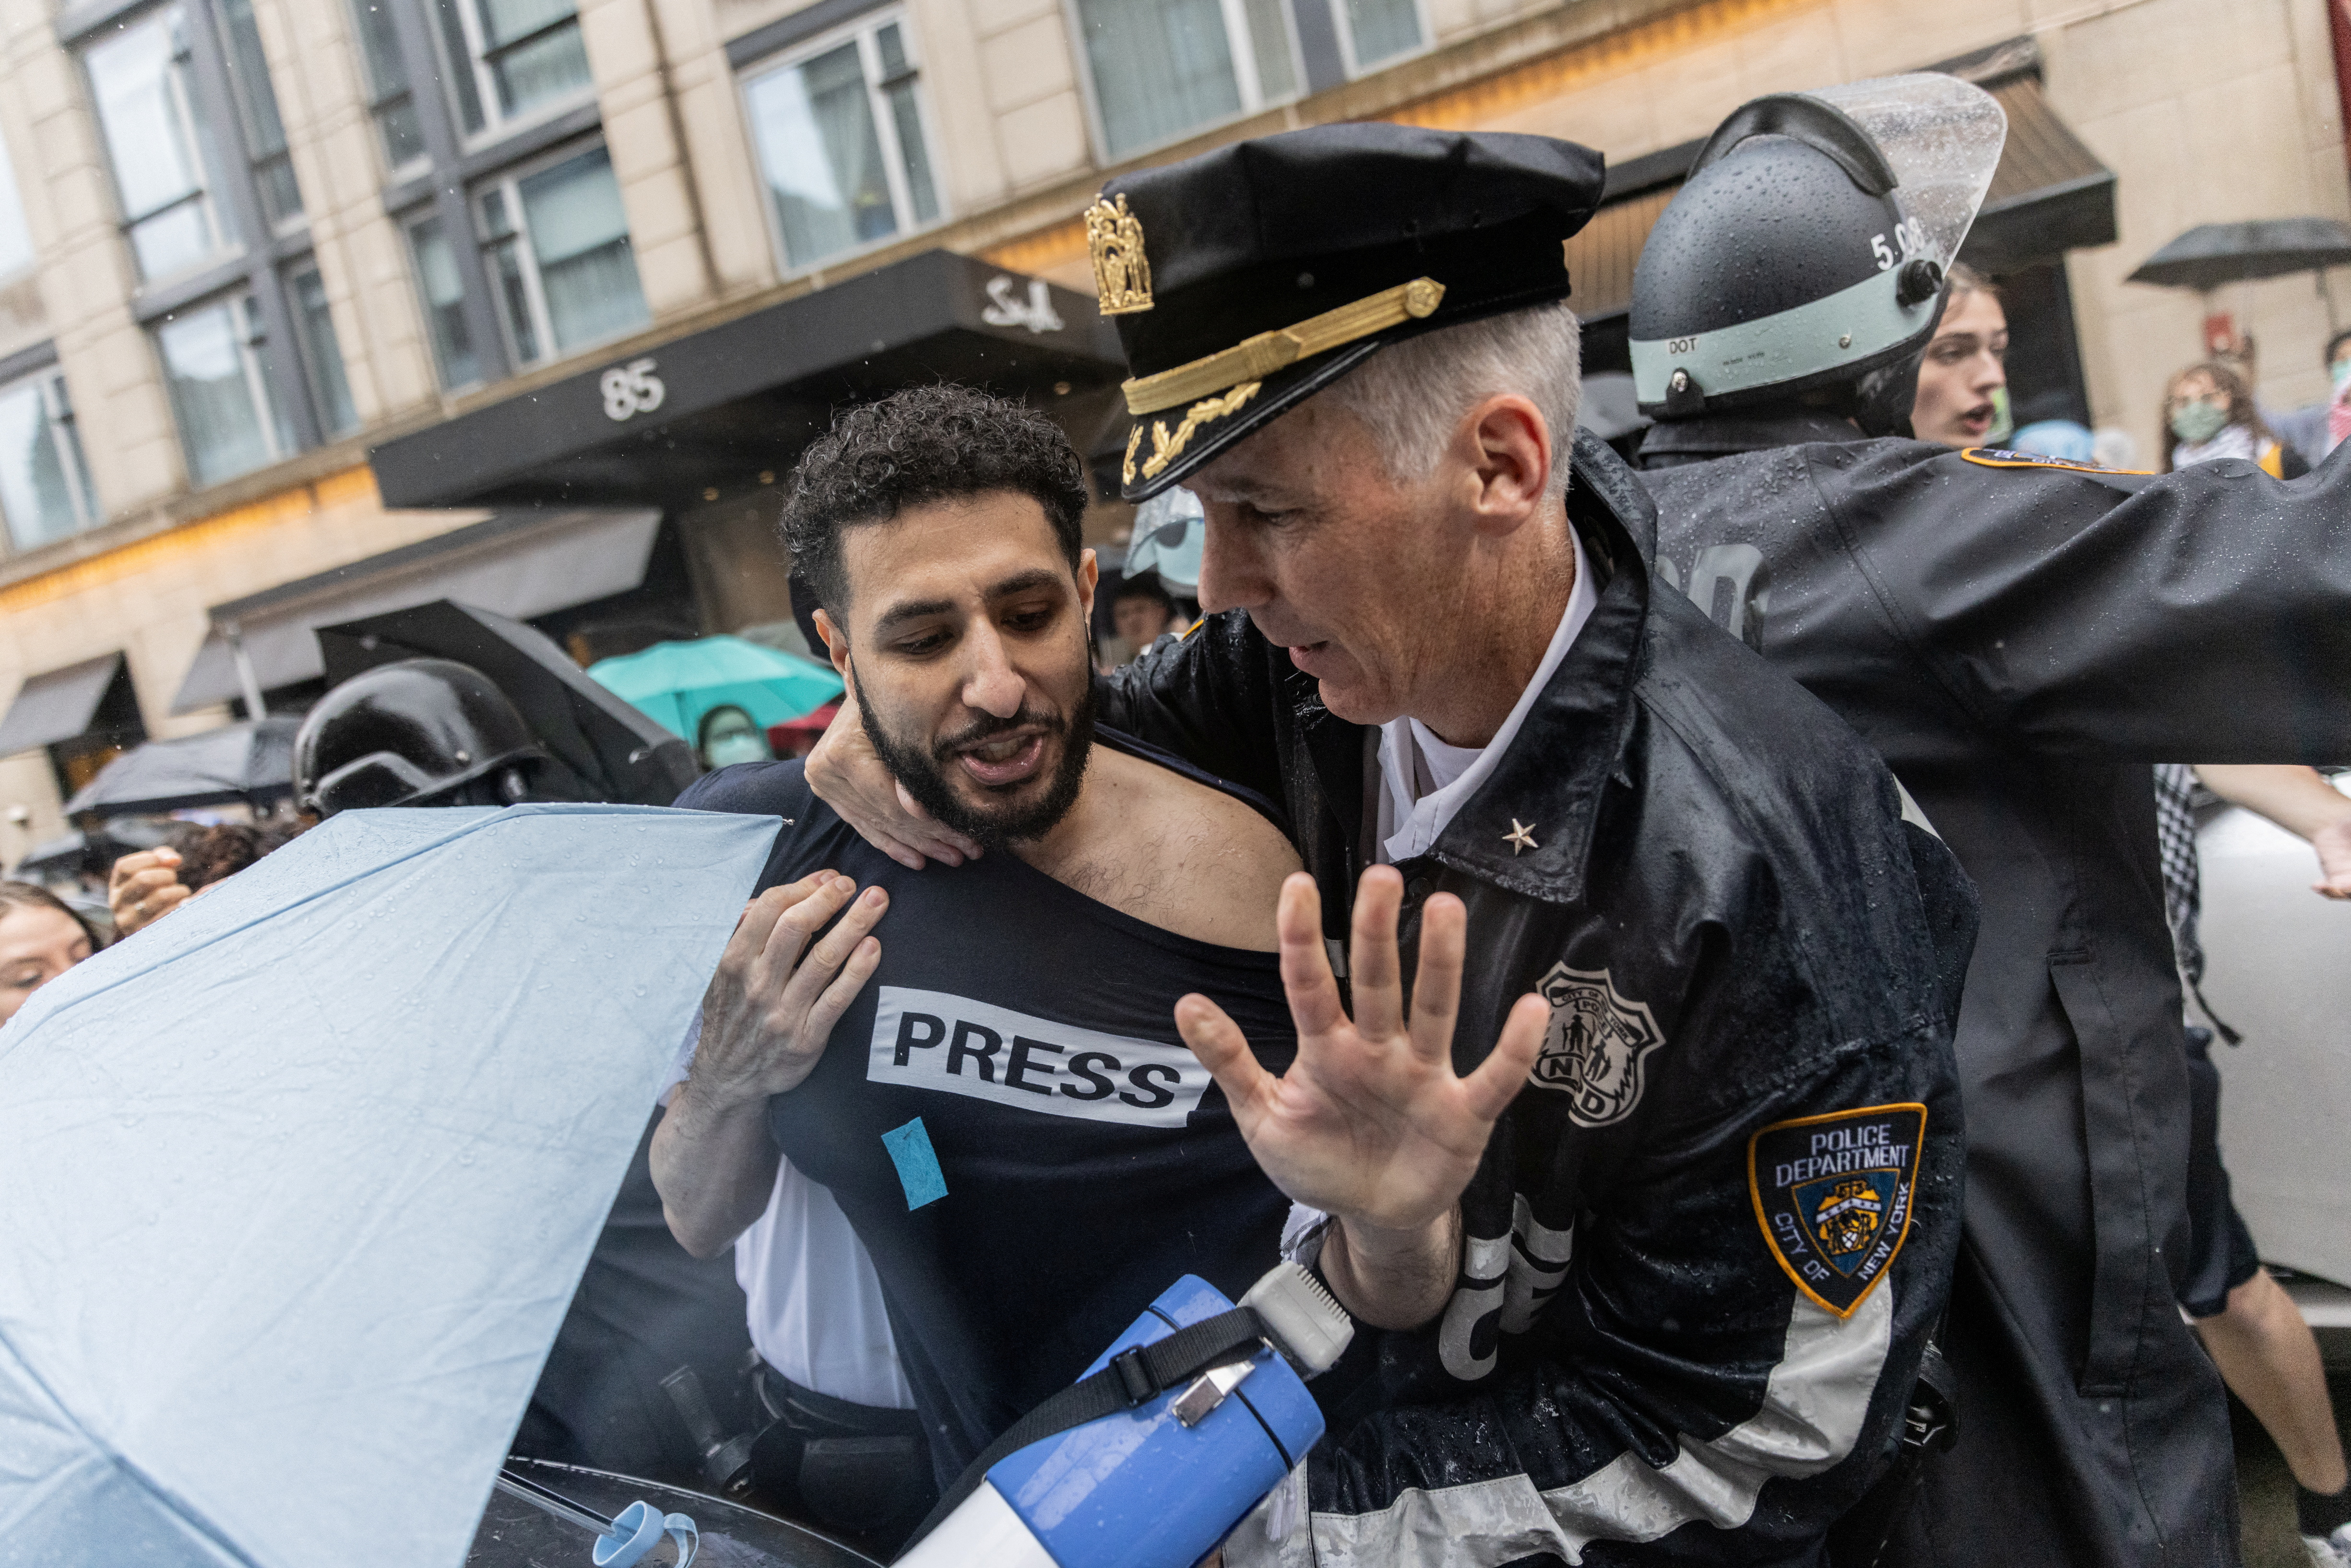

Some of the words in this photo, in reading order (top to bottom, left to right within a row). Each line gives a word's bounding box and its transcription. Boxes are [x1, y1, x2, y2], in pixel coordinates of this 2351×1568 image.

[1670, 337, 1697, 354] DOT
[600, 358, 665, 421] 85
[1562, 990, 1582, 1001] CITY
[893, 1011, 1181, 1109] PRESS
[1811, 1124, 1892, 1156] POLICE
[1776, 1145, 1910, 1188] DEPARTMENT
[1775, 1212, 1808, 1255] CITY
[1803, 1259, 1830, 1281] OF
[1858, 1240, 1891, 1281] NEW
[1886, 1182, 1910, 1235] YORK
